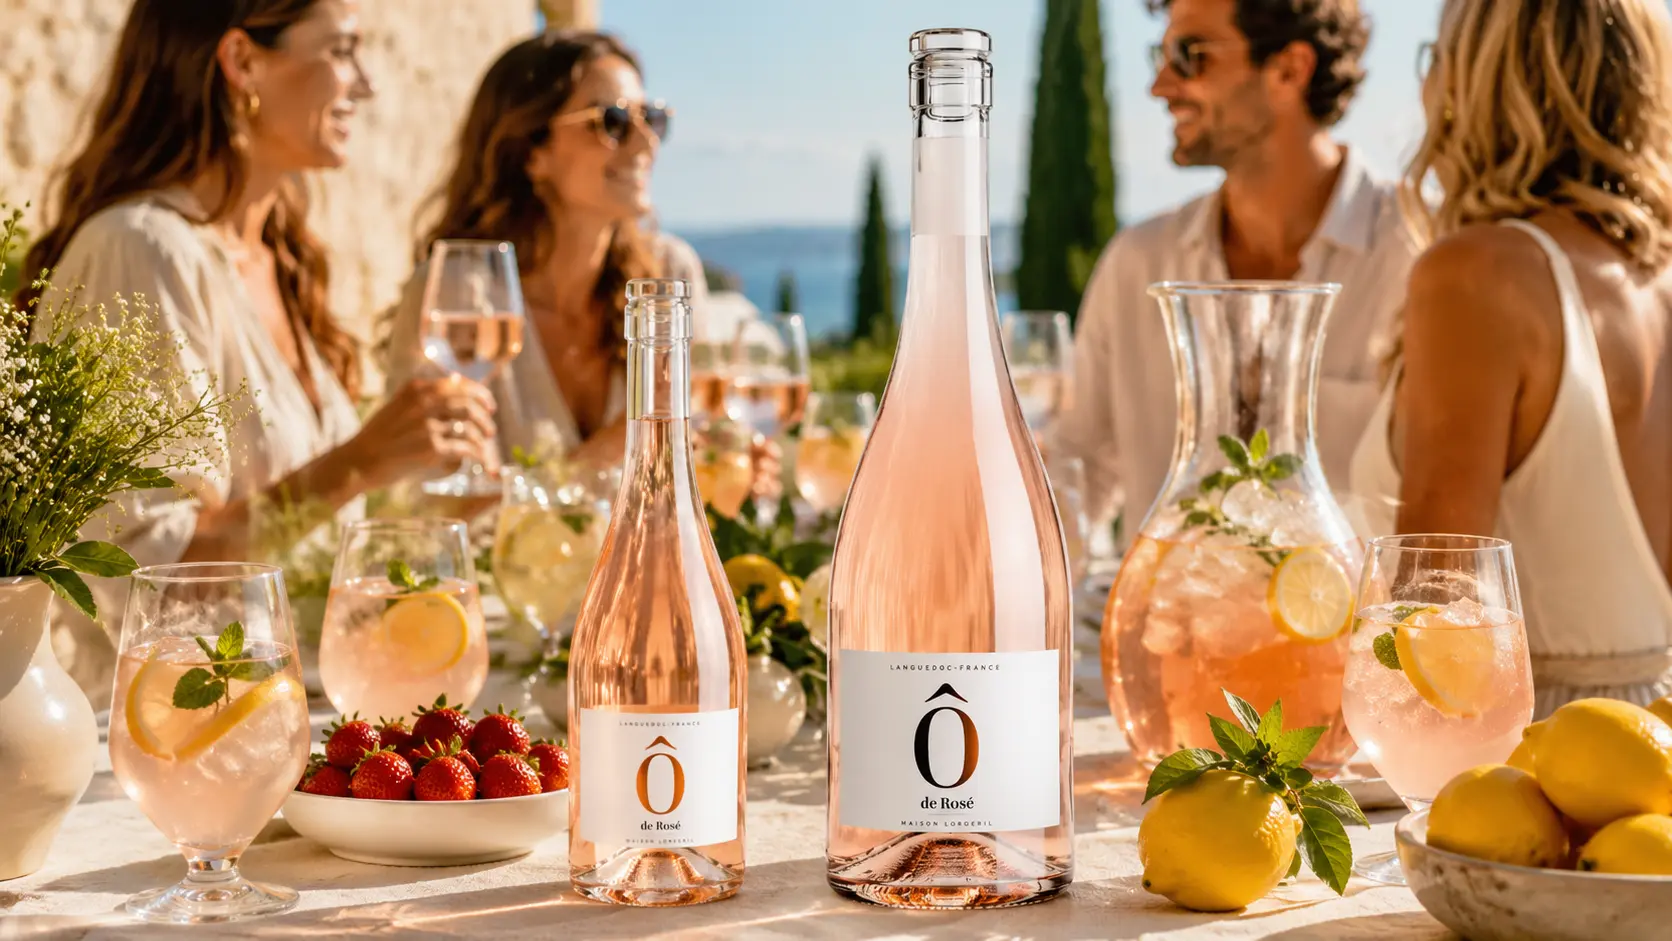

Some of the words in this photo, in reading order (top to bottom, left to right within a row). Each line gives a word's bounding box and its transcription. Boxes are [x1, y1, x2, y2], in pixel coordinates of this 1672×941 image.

[914, 682, 979, 789] Ô
[636, 735, 685, 815] Ô
[640, 820, 654, 831] de
[656, 820, 681, 831] Rosé
[920, 796, 938, 810] de
[940, 796, 975, 810] Rosé
